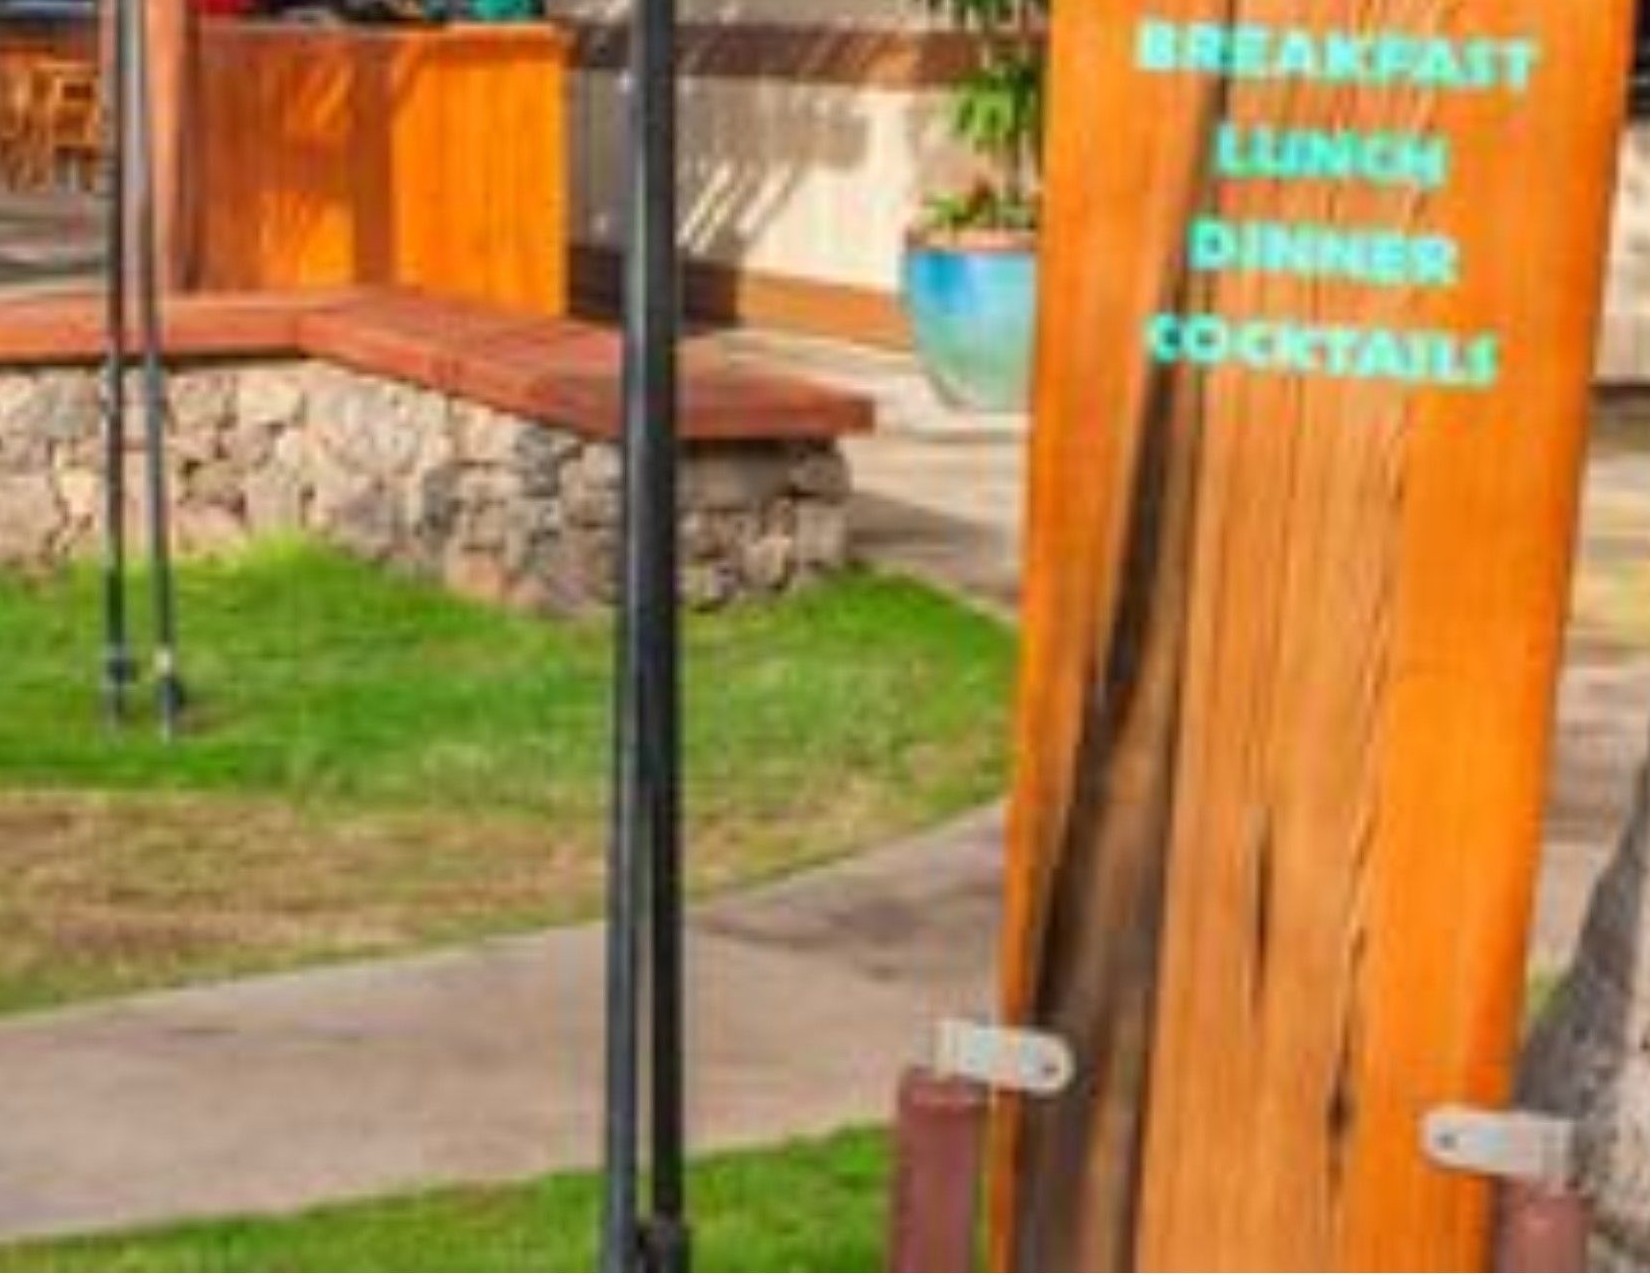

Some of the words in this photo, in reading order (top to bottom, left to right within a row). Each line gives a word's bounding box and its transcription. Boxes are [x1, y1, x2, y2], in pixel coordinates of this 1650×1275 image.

[1137, 19, 1538, 89] BREAKFAST
[1217, 123, 1448, 187] LUNCH
[1189, 218, 1456, 285] DINNER
[1149, 315, 1497, 387] COCKTAILS
